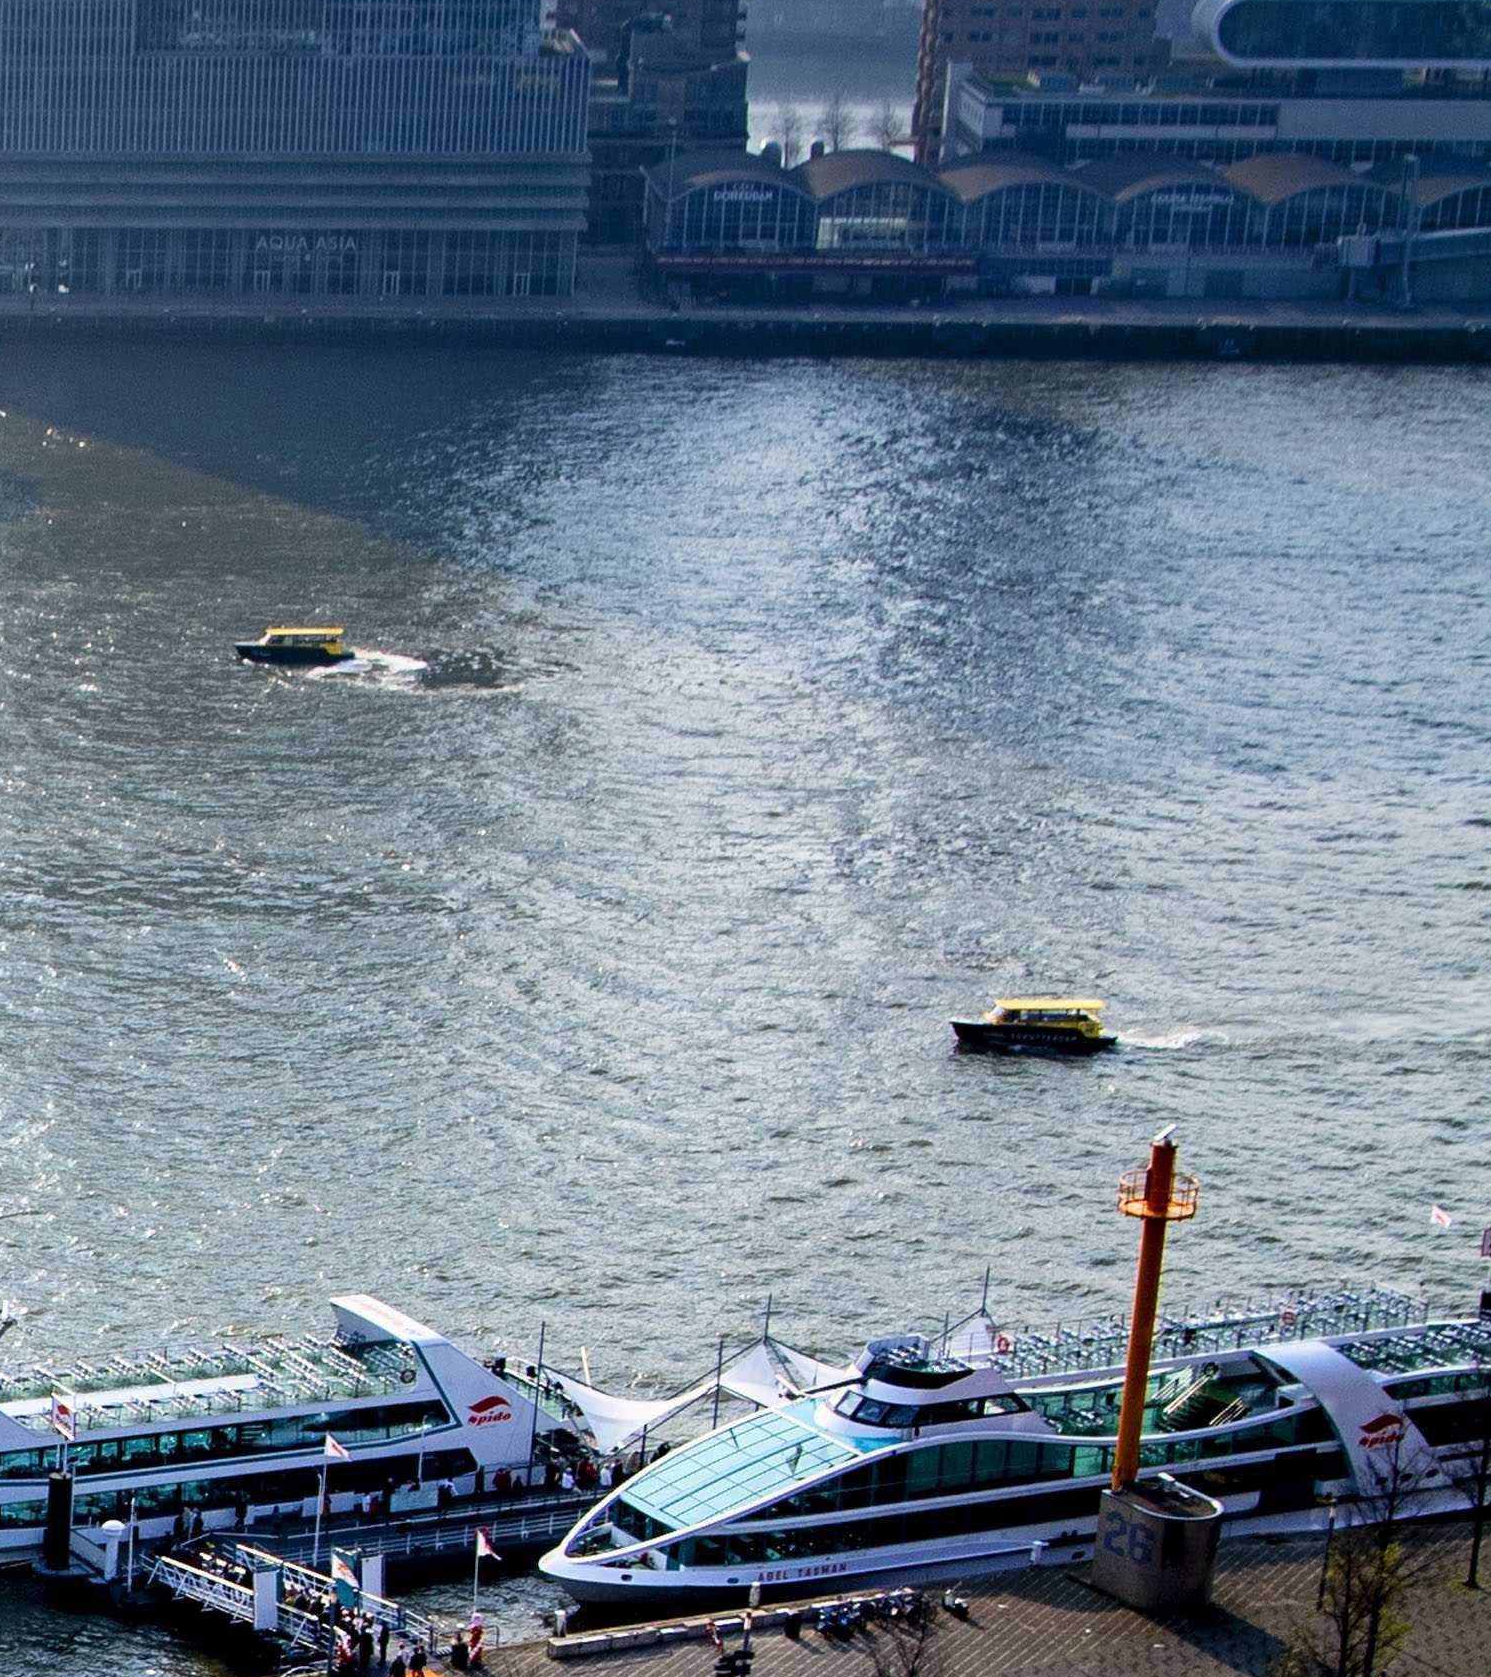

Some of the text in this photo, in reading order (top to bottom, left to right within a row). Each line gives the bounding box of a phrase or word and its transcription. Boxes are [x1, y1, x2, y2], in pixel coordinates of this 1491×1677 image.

[255, 235, 357, 251] AQUA ASIA
[1104, 1510, 1153, 1562] 26
[797, 1562, 847, 1578] TASMAN
